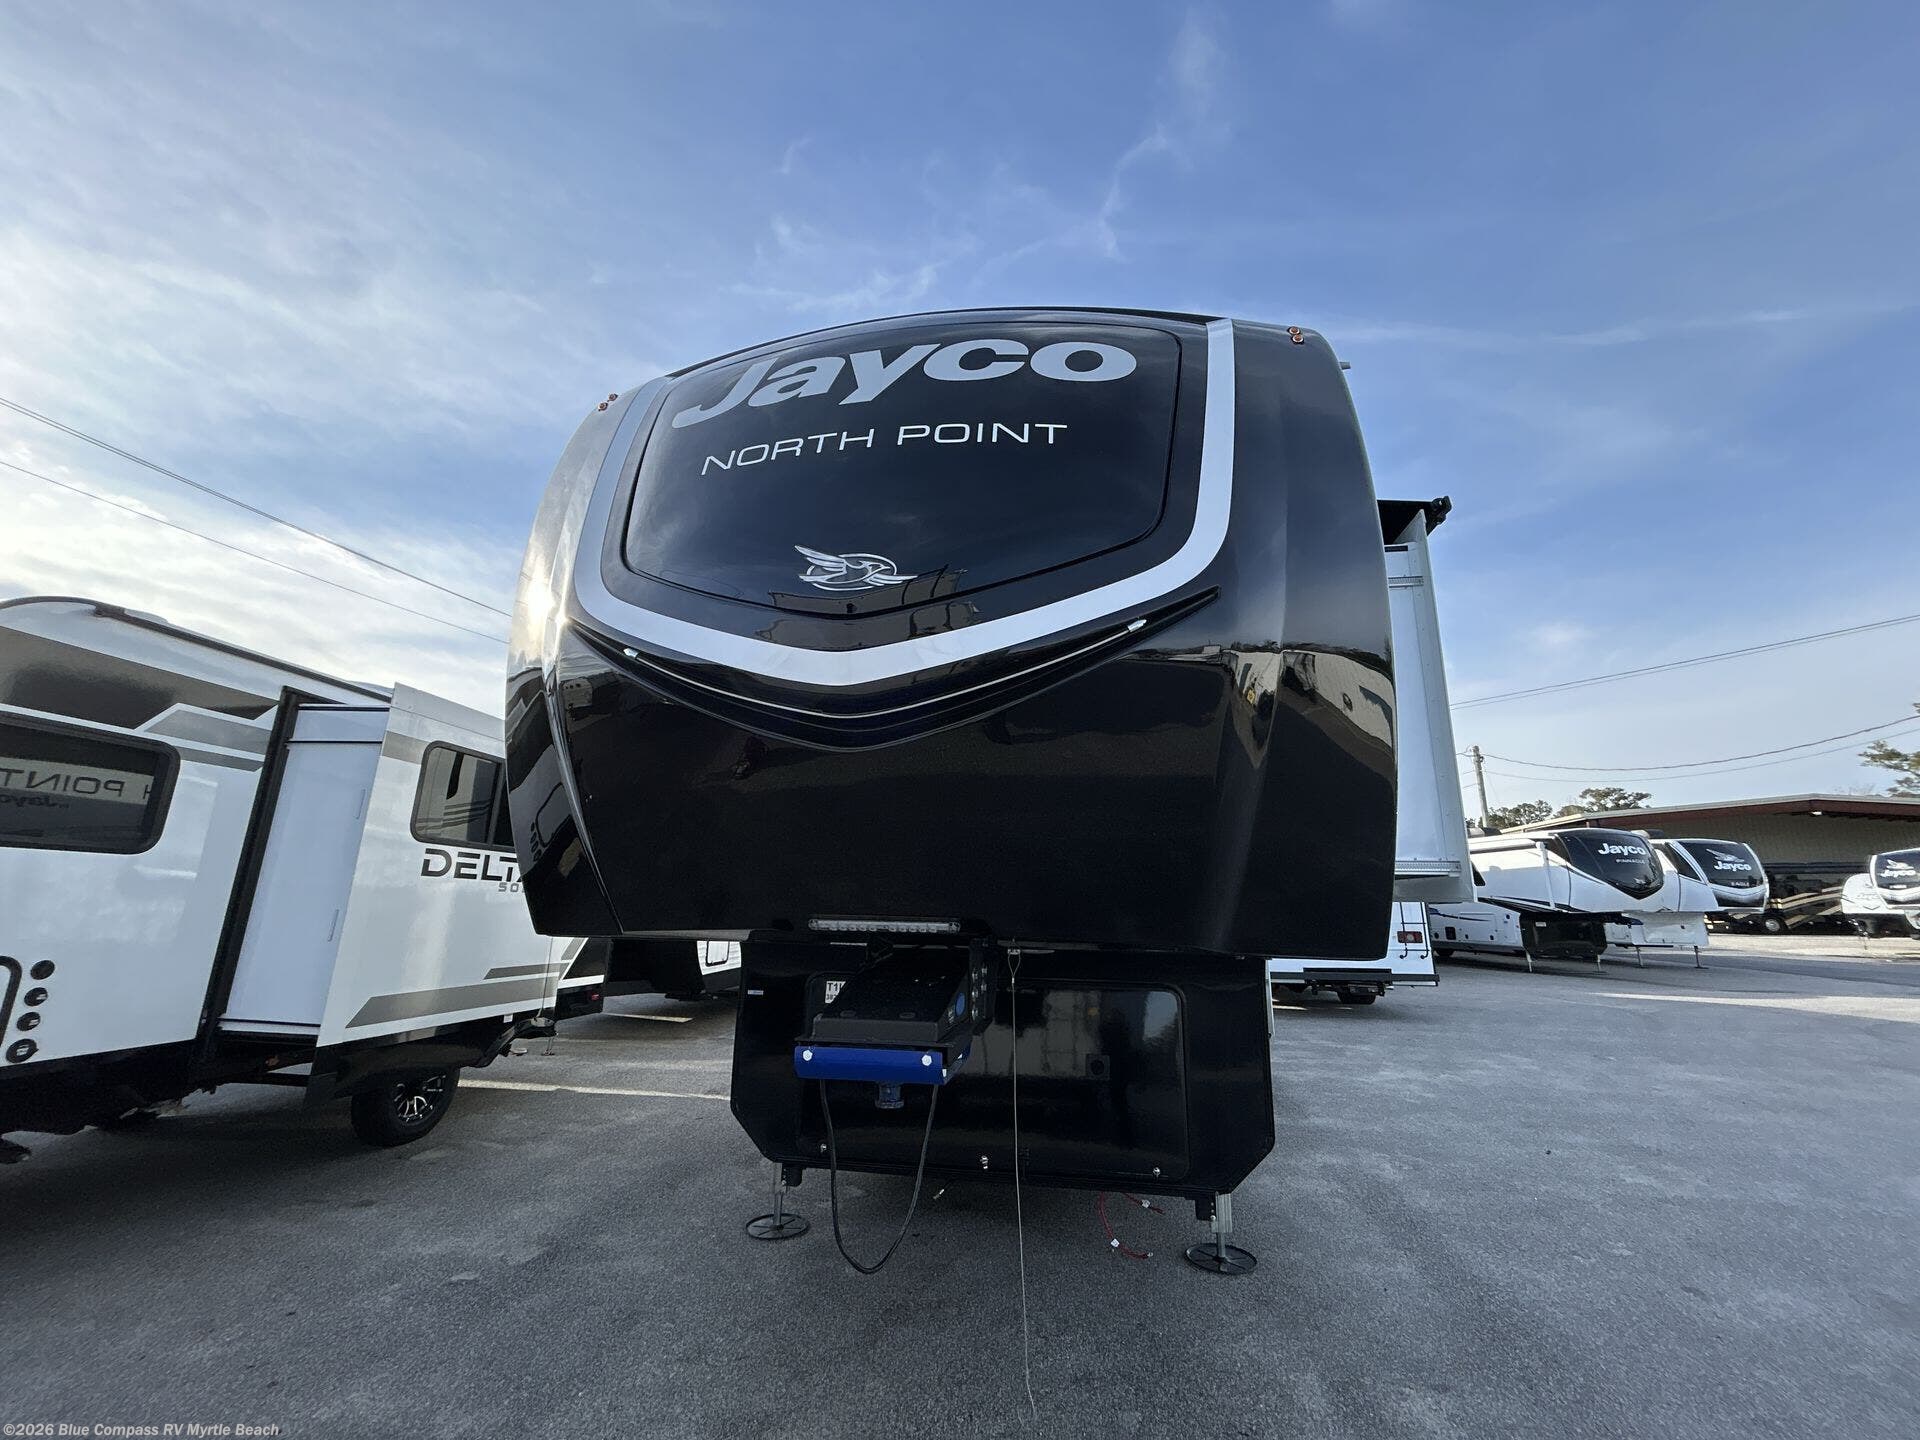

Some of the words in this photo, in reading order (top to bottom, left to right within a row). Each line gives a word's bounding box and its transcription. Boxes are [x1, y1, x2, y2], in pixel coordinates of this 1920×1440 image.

[671, 338, 1137, 429] Jayco
[702, 428, 875, 475] NORTH
[897, 422, 1067, 445] POINT
[1598, 843, 1646, 856] Jayco
[421, 848, 522, 882] DELT
[1714, 861, 1752, 872] Jayco
[498, 882, 526, 893] SO
